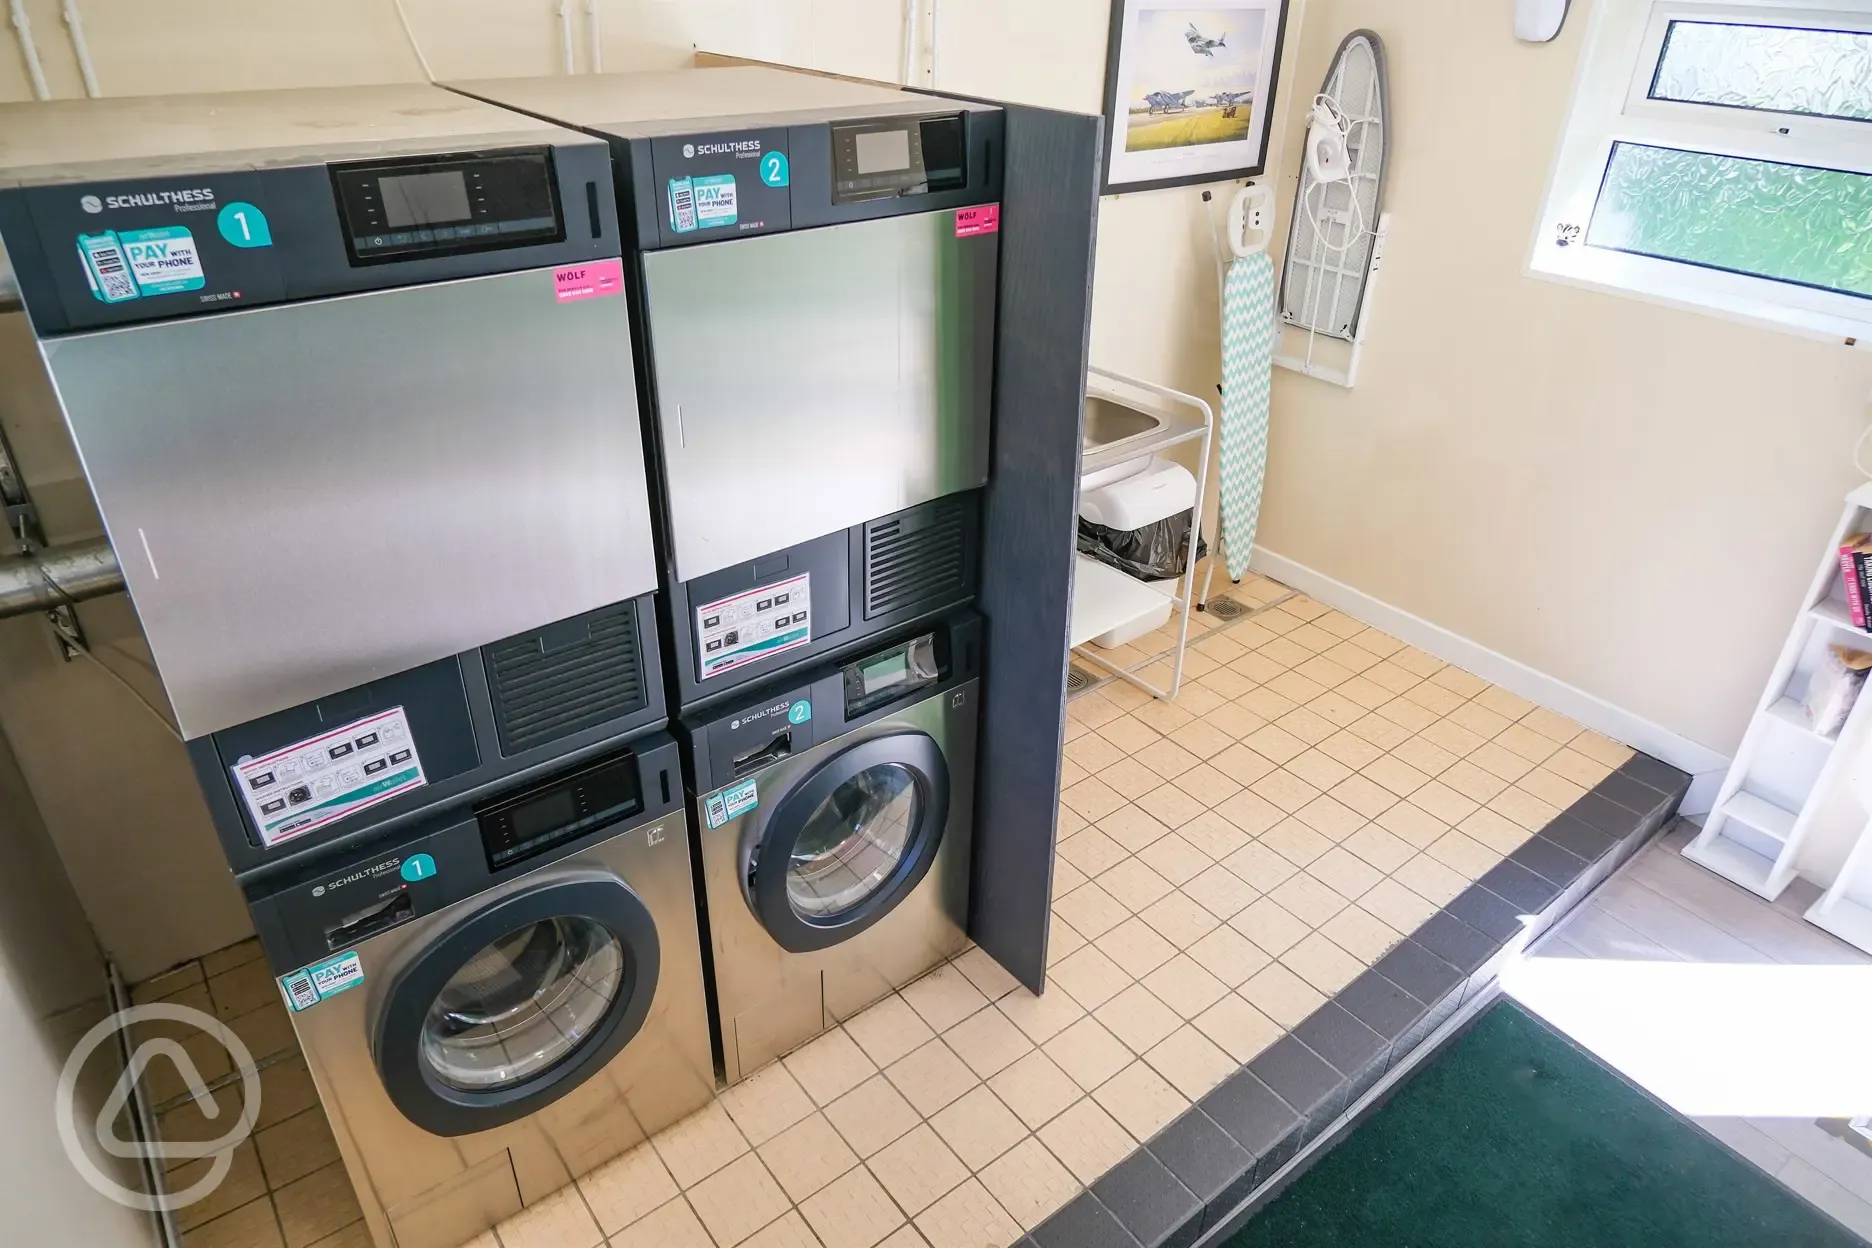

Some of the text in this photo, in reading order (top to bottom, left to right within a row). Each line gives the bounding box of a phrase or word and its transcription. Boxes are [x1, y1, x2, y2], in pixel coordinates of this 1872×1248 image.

[697, 140, 761, 155] SCHULTHESS
[768, 158, 781, 182] 2
[106, 188, 215, 209] SCHULTHESS
[696, 188, 721, 201] PAY
[174, 202, 217, 213] Professional
[712, 200, 734, 208] PHONE
[958, 212, 977, 221] WOLF
[233, 211, 251, 241] 1
[128, 243, 192, 261] PAY WITH
[134, 257, 194, 270] YOUR PHONE
[557, 270, 586, 283] WOLF
[200, 292, 232, 303] SWISS MADE
[741, 700, 790, 725] SCHULTHESS
[795, 706, 804, 721] 2
[726, 791, 746, 804] PAY
[328, 857, 400, 891] SCHULTHESS
[411, 860, 423, 876] 1
[315, 964, 343, 982] PAY
[342, 962, 358, 972] WITH
[318, 977, 332, 986] YOUR
[333, 968, 358, 982] PHONE
